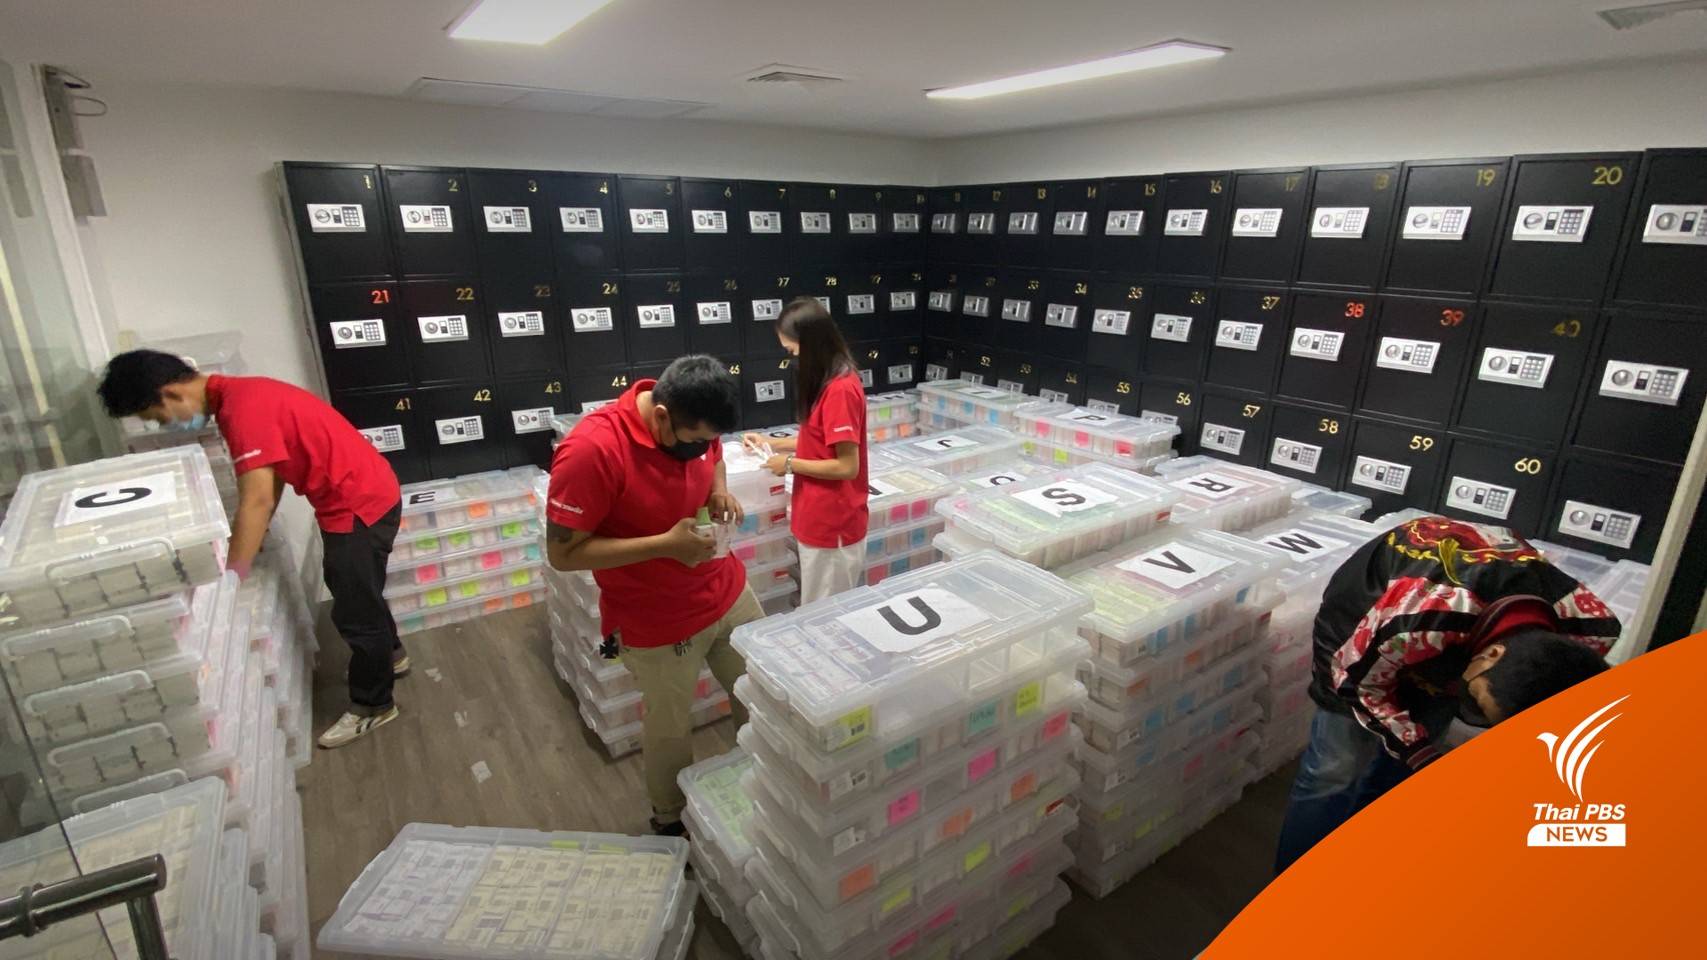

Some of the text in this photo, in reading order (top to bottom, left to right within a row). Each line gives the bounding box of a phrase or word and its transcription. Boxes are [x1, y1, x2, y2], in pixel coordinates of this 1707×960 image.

[364, 175, 371, 189] 1
[1475, 168, 1496, 187] 19
[1592, 166, 1622, 185] 20
[448, 179, 458, 192] 2
[528, 179, 537, 192] 3
[600, 182, 608, 194] 4
[665, 184, 673, 195] 5
[1144, 183, 1156, 196] 15
[1211, 180, 1222, 193] 16
[1285, 176, 1298, 192] 17
[724, 187, 732, 198] 6
[778, 188, 786, 199] 7
[456, 288, 474, 300] 22
[603, 283, 617, 294] 24
[1075, 283, 1087, 294] 34
[372, 290, 389, 304] 21
[1262, 296, 1280, 309] 37
[1345, 303, 1364, 318] 38
[1440, 309, 1464, 326] 39
[981, 356, 990, 366] 52
[545, 382, 561, 393] 43
[612, 376, 627, 387] 44
[1117, 382, 1130, 393] 55
[474, 389, 491, 401] 42
[1176, 392, 1191, 405] 56
[1243, 405, 1260, 418] 57
[1319, 419, 1338, 434] 58
[1410, 436, 1433, 451] 59
[1515, 458, 1541, 474] 60
[1189, 478, 1234, 492] R
[75, 487, 152, 508] C
[409, 491, 436, 504] E
[1042, 488, 1086, 506] S
[1267, 533, 1323, 554] W
[1143, 551, 1196, 573] V
[876, 596, 942, 635] U
